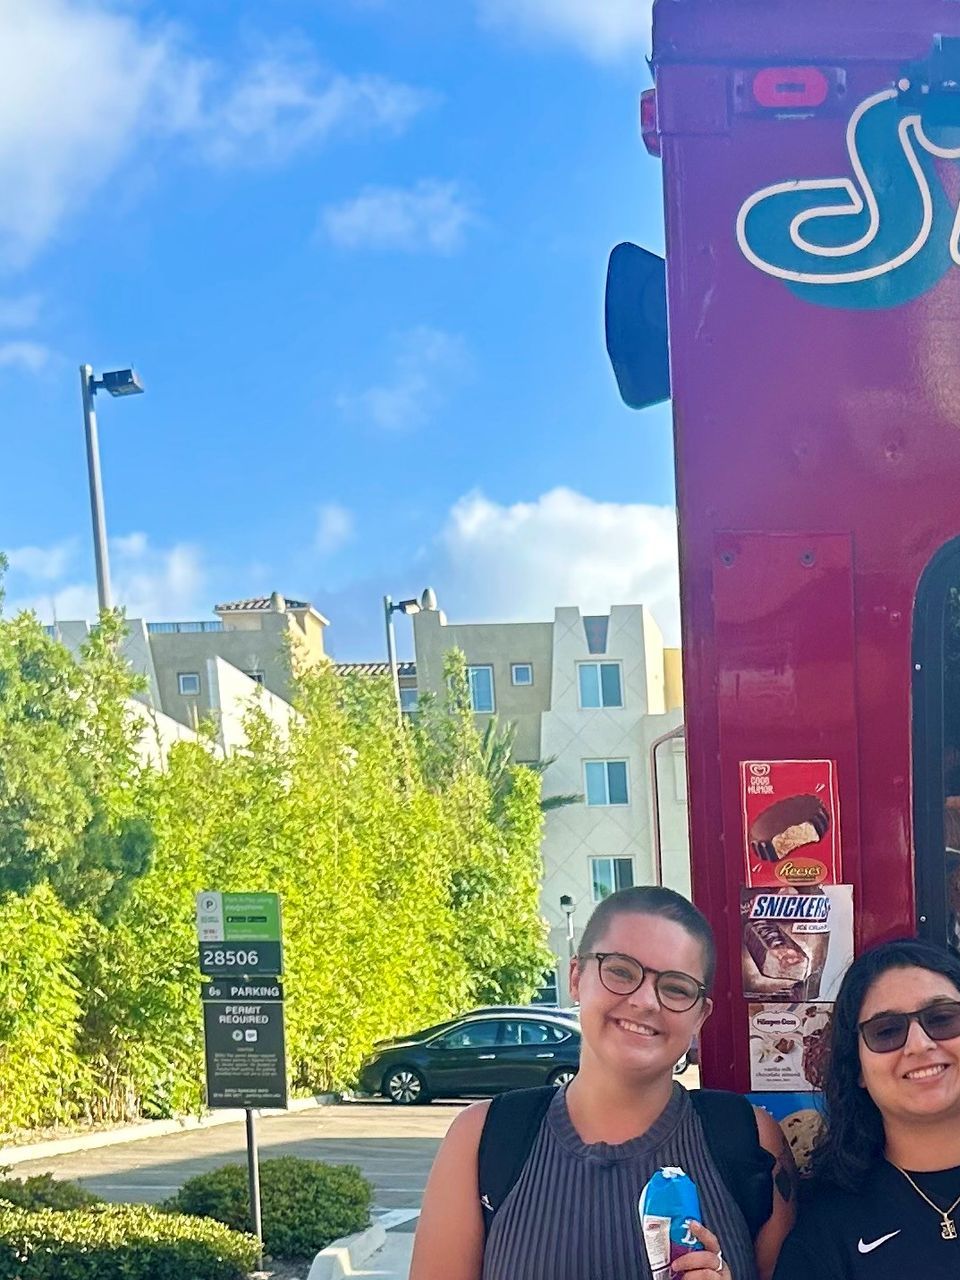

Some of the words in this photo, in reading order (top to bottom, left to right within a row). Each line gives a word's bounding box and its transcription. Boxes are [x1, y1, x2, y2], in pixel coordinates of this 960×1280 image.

[203, 950, 259, 965] 28506
[230, 986, 280, 997] PARKING
[225, 1005, 261, 1015] PERMIT
[219, 1014, 269, 1024] REQUIRED
